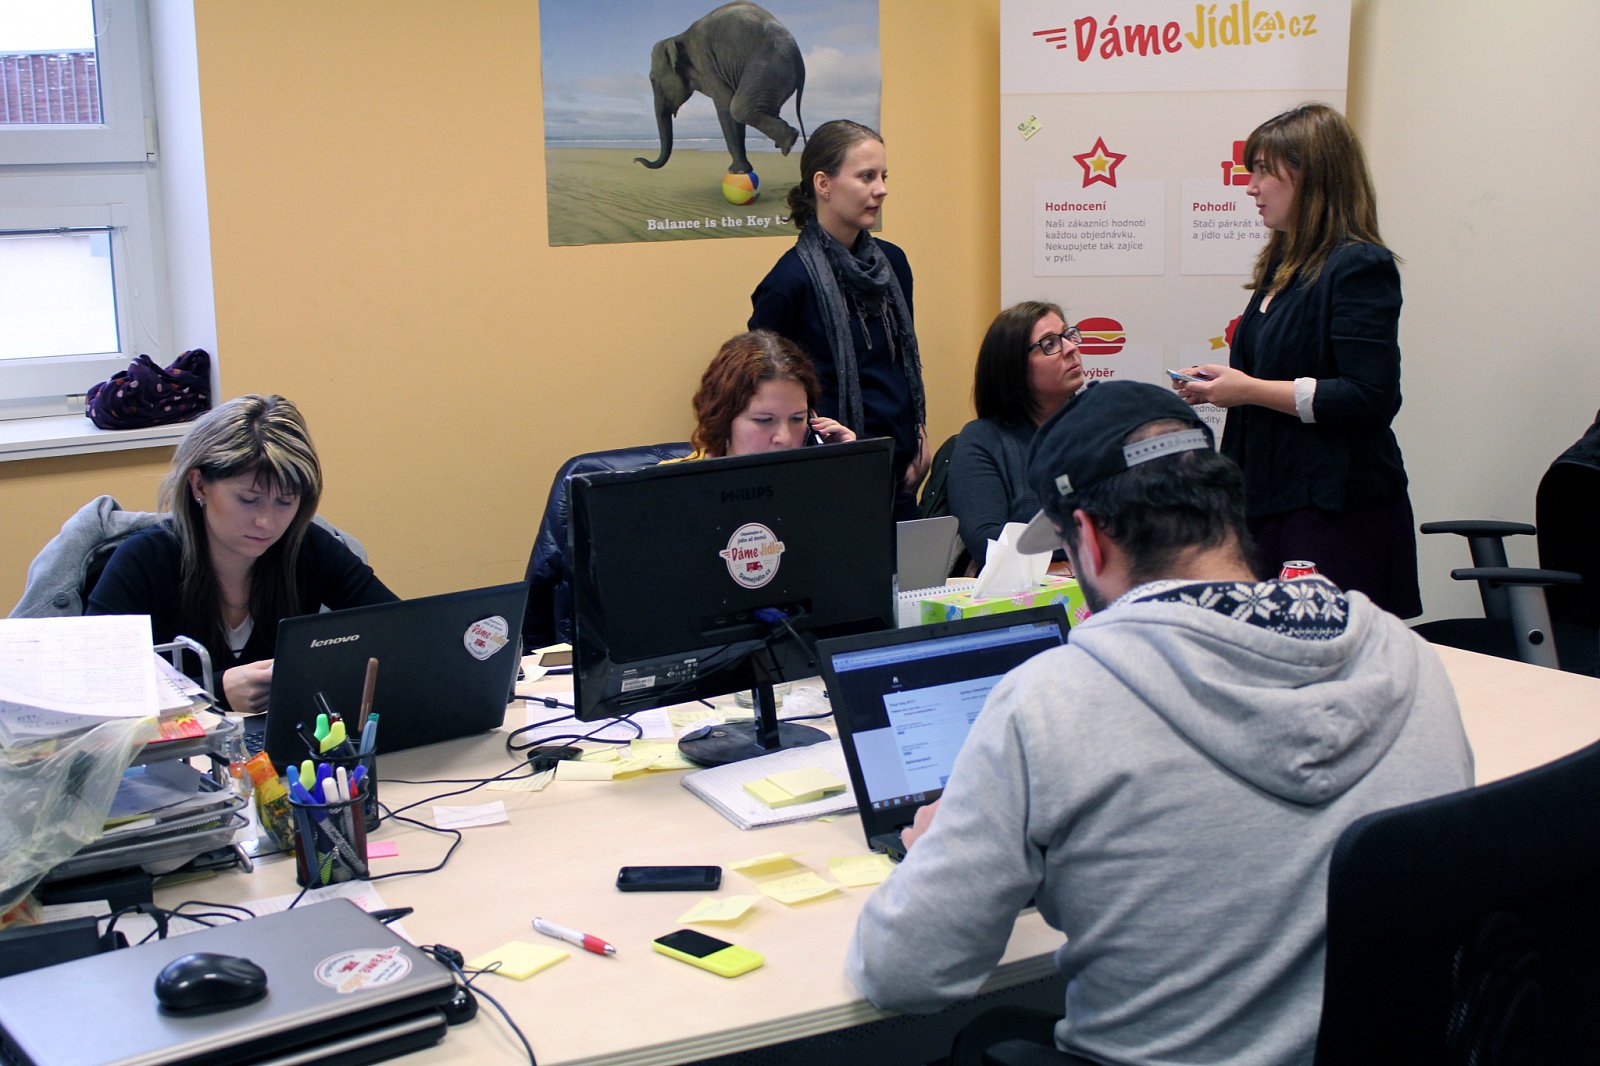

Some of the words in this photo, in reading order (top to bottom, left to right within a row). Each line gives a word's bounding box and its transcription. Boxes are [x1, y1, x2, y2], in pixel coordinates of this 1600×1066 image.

[1045, 201, 1107, 211] Hodnocení
[1192, 201, 1237, 212] Pohodlí
[646, 218, 701, 231] Balance
[704, 217, 717, 228] is
[721, 216, 743, 227] the
[746, 215, 771, 228] Key
[1045, 219, 1065, 228] Naši
[1067, 218, 1109, 227] zákazníci
[1111, 218, 1146, 227] hodnotí
[1192, 219, 1216, 228] Stačí
[1218, 219, 1252, 229] párkrát
[1045, 230, 1078, 240] každou
[1080, 230, 1136, 241] objednávku.
[1200, 231, 1221, 241] jídlo
[1223, 231, 1234, 239] už
[1236, 231, 1246, 241] je
[1045, 242, 1097, 252] Nekupujete
[1099, 242, 1114, 250] tak
[1117, 241, 1144, 252] zajíce
[1053, 254, 1076, 263] pytli.
[1083, 368, 1115, 379] výběr
[720, 485, 774, 504] PHILIPS
[310, 634, 360, 648] lenovo
